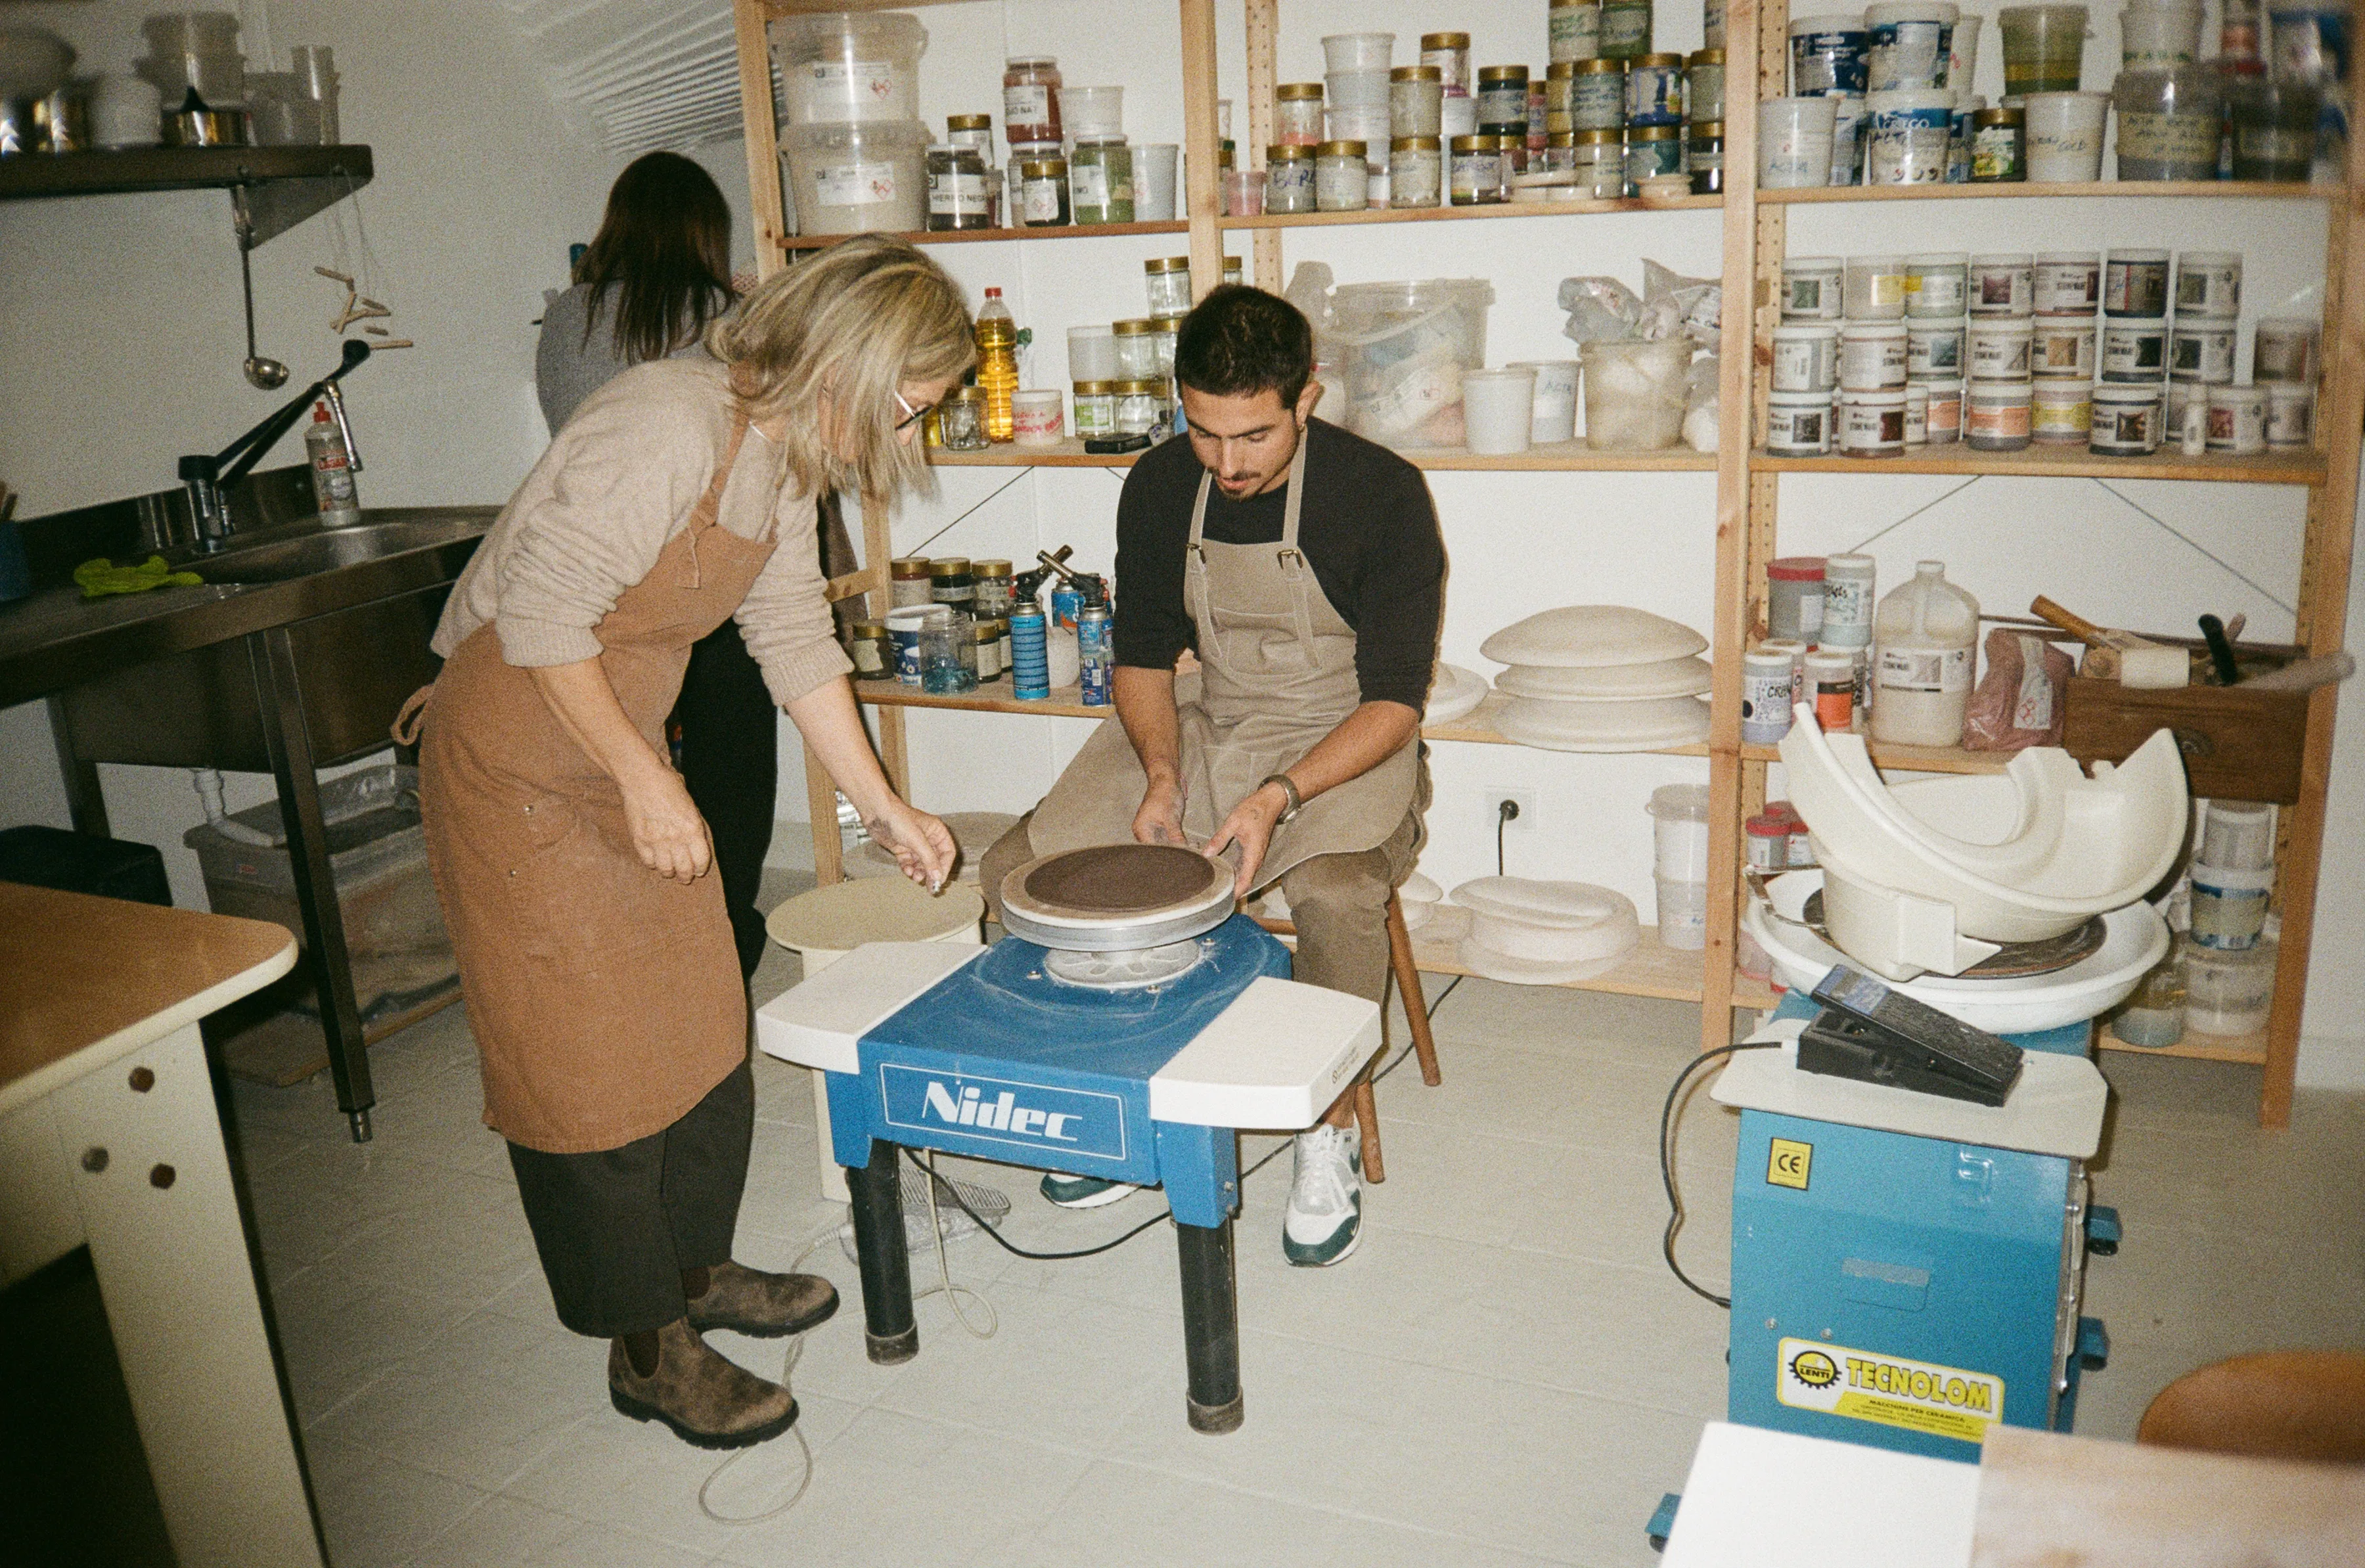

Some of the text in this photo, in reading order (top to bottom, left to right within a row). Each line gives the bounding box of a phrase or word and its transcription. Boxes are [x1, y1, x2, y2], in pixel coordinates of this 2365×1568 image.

[922, 1081, 1083, 1141] Nidec
[1778, 1154, 1801, 1175] CE
[1799, 1367, 1830, 1380] LENTI
[1846, 1357, 1992, 1413] TECNOLOM
[1869, 1400, 1910, 1412] MACCHINE
[1926, 1409, 1965, 1423] CERAMICA
